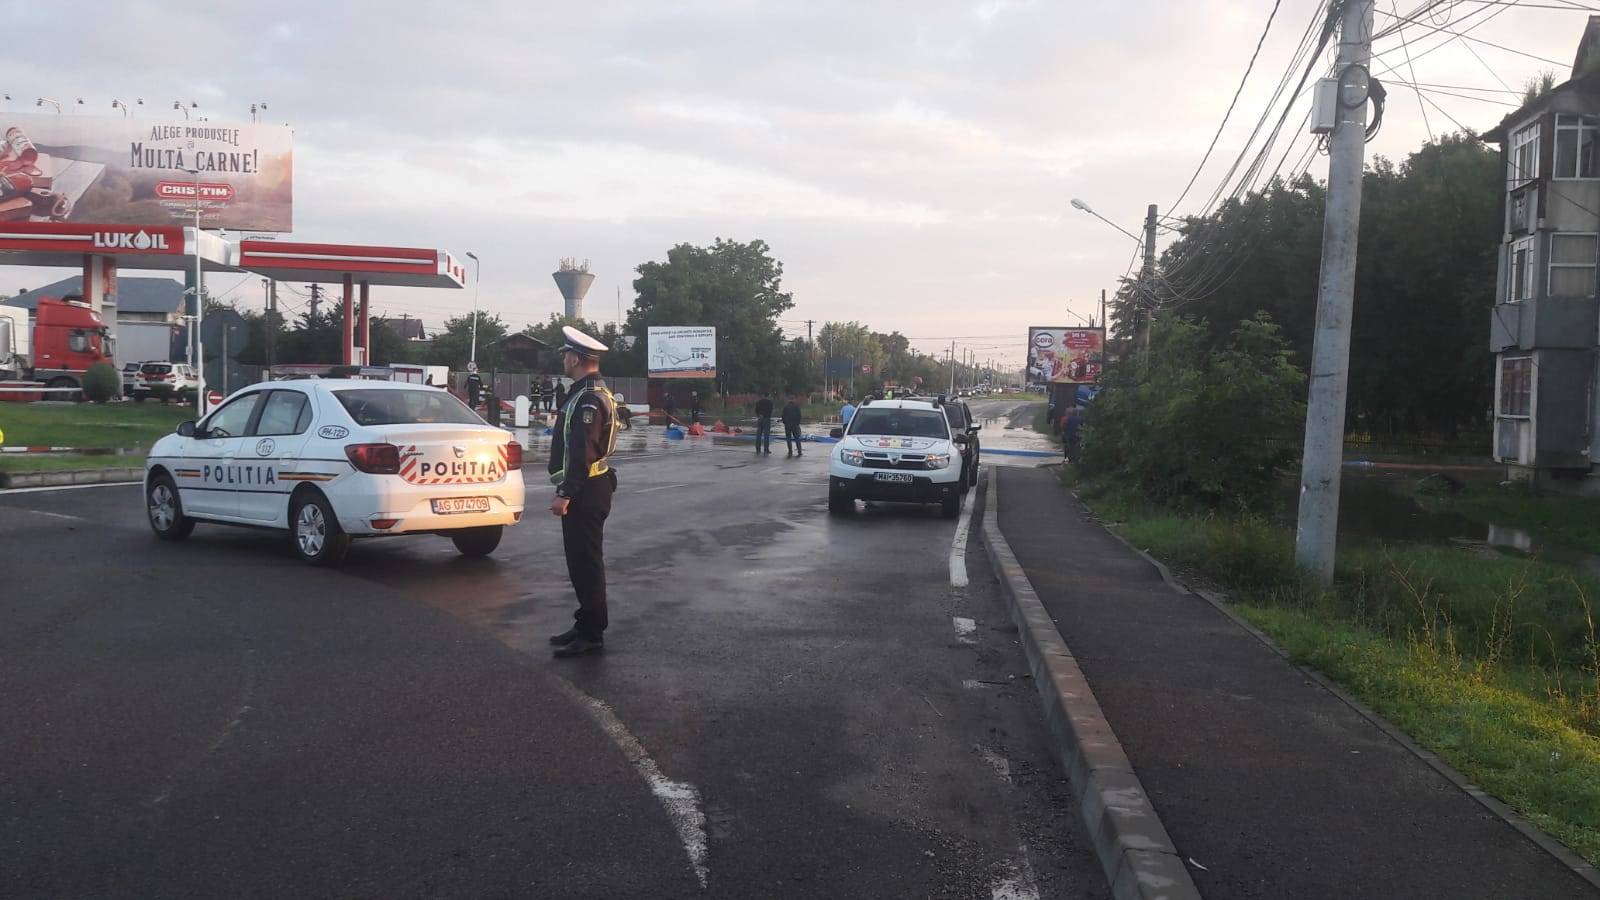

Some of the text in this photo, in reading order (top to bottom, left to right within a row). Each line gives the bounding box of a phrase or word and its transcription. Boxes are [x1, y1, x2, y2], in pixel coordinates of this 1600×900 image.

[150, 125, 240, 147] ALEGE PRODUSELE
[195, 149, 258, 174] CARNE!
[93, 229, 170, 250] LUKOIL
[1035, 335, 1053, 344] cora
[203, 464, 276, 485] POLITIA
[438, 498, 488, 512] AG 074709
